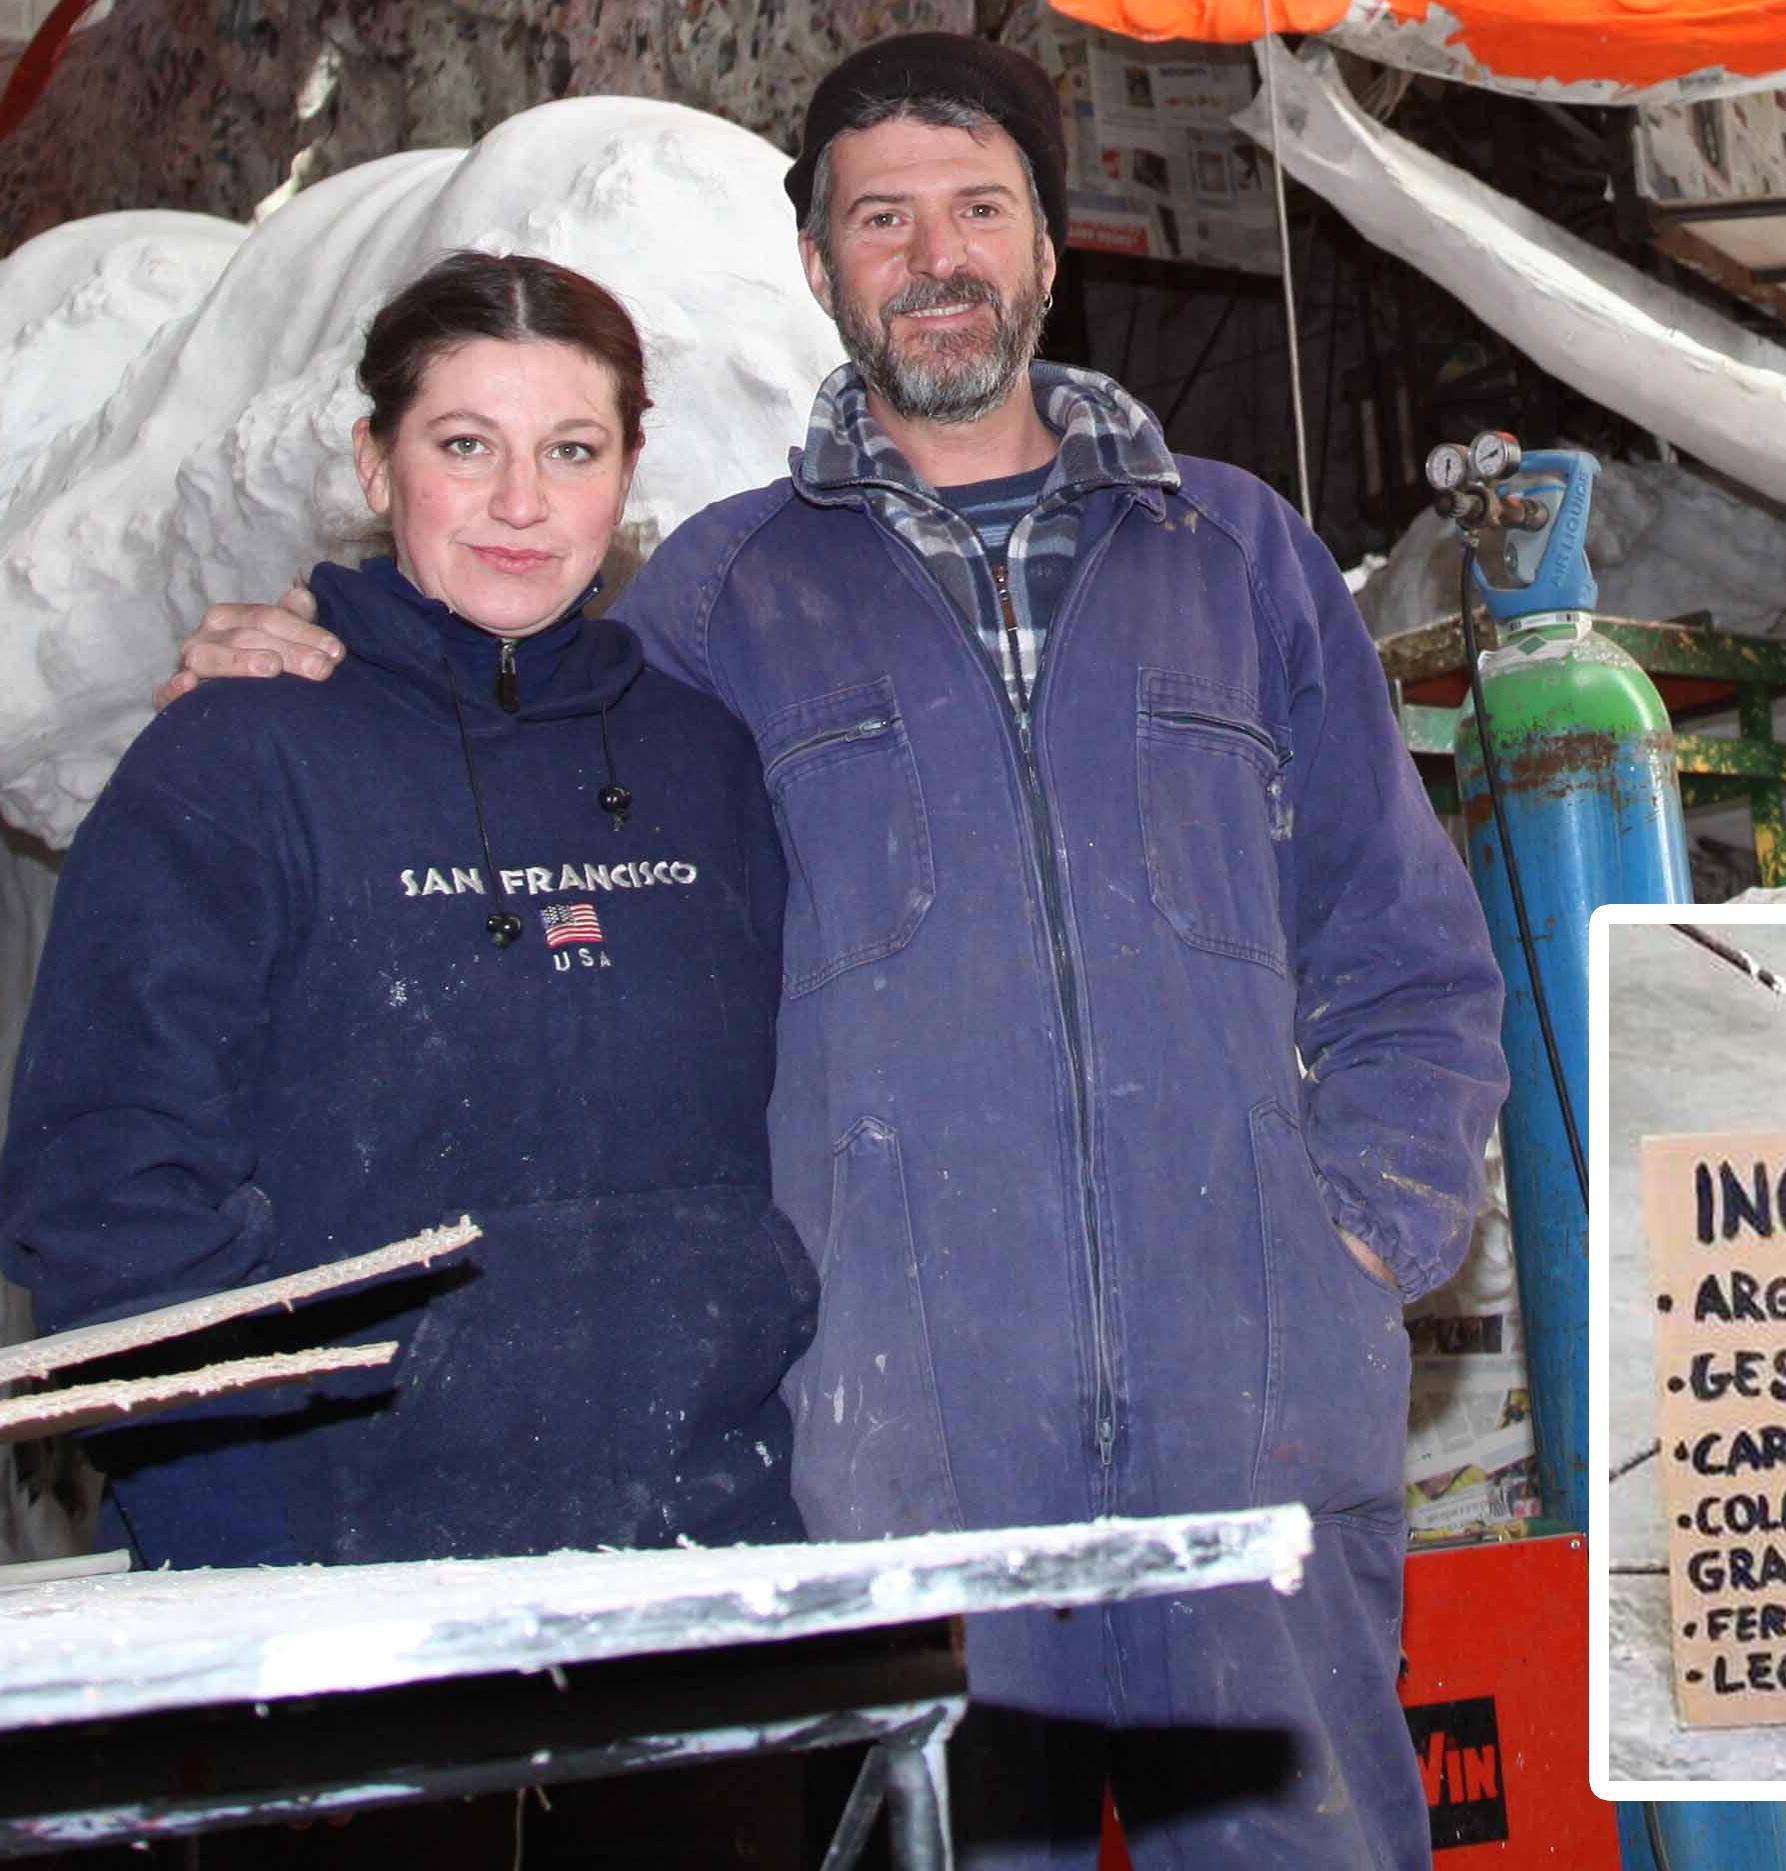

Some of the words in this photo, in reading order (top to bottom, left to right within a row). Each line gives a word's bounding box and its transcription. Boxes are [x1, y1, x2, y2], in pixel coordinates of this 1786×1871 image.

[400, 867, 487, 897] SAN
[499, 861, 697, 896] FRANCISCO
[553, 947, 612, 972] USA
